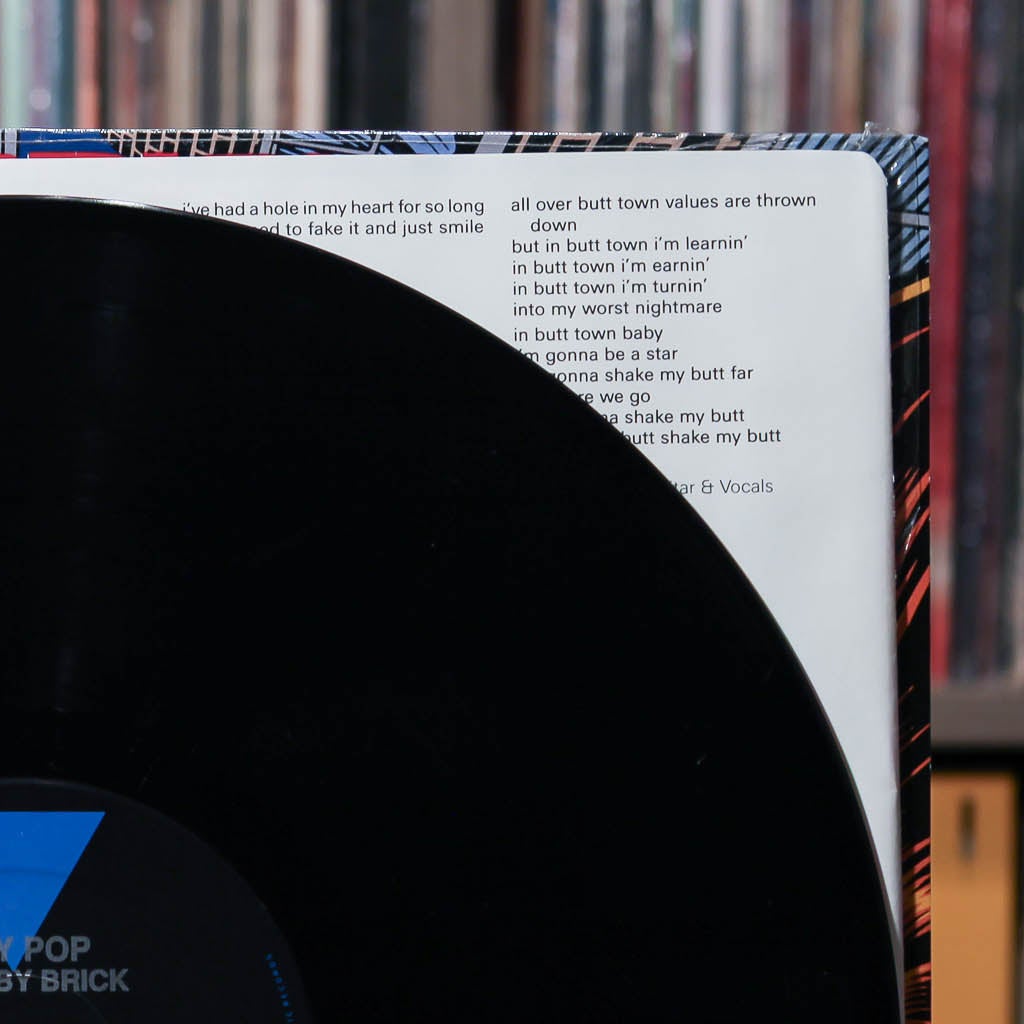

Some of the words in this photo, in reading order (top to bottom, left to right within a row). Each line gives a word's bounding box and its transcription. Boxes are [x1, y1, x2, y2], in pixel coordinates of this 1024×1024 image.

[511, 197, 529, 212] all
[536, 200, 572, 211] over
[578, 196, 611, 210] butt
[618, 197, 659, 210] town
[665, 194, 718, 209] values
[725, 197, 750, 208] are
[757, 193, 816, 207] thrown
[286, 224, 302, 236] to
[308, 221, 343, 235] fake
[350, 221, 359, 235] it
[365, 220, 396, 235] and
[402, 220, 432, 237] just
[439, 219, 483, 234] smile
[531, 218, 576, 232] down
[512, 239, 539, 253] but
[546, 239, 560, 253] in
[567, 238, 600, 252] butt
[606, 239, 647, 251] town
[655, 236, 679, 251] i'm
[686, 235, 747, 250] learnin'
[514, 302, 545, 316] into
[552, 305, 576, 319] my
[582, 302, 629, 315] worst
[636, 299, 722, 318] nightmare
[546, 351, 598, 366] gonna
[605, 347, 625, 361] be
[631, 350, 640, 361] a
[647, 347, 678, 360] star
[24, 935, 91, 962] POP
[41, 969, 129, 992] BRICK
